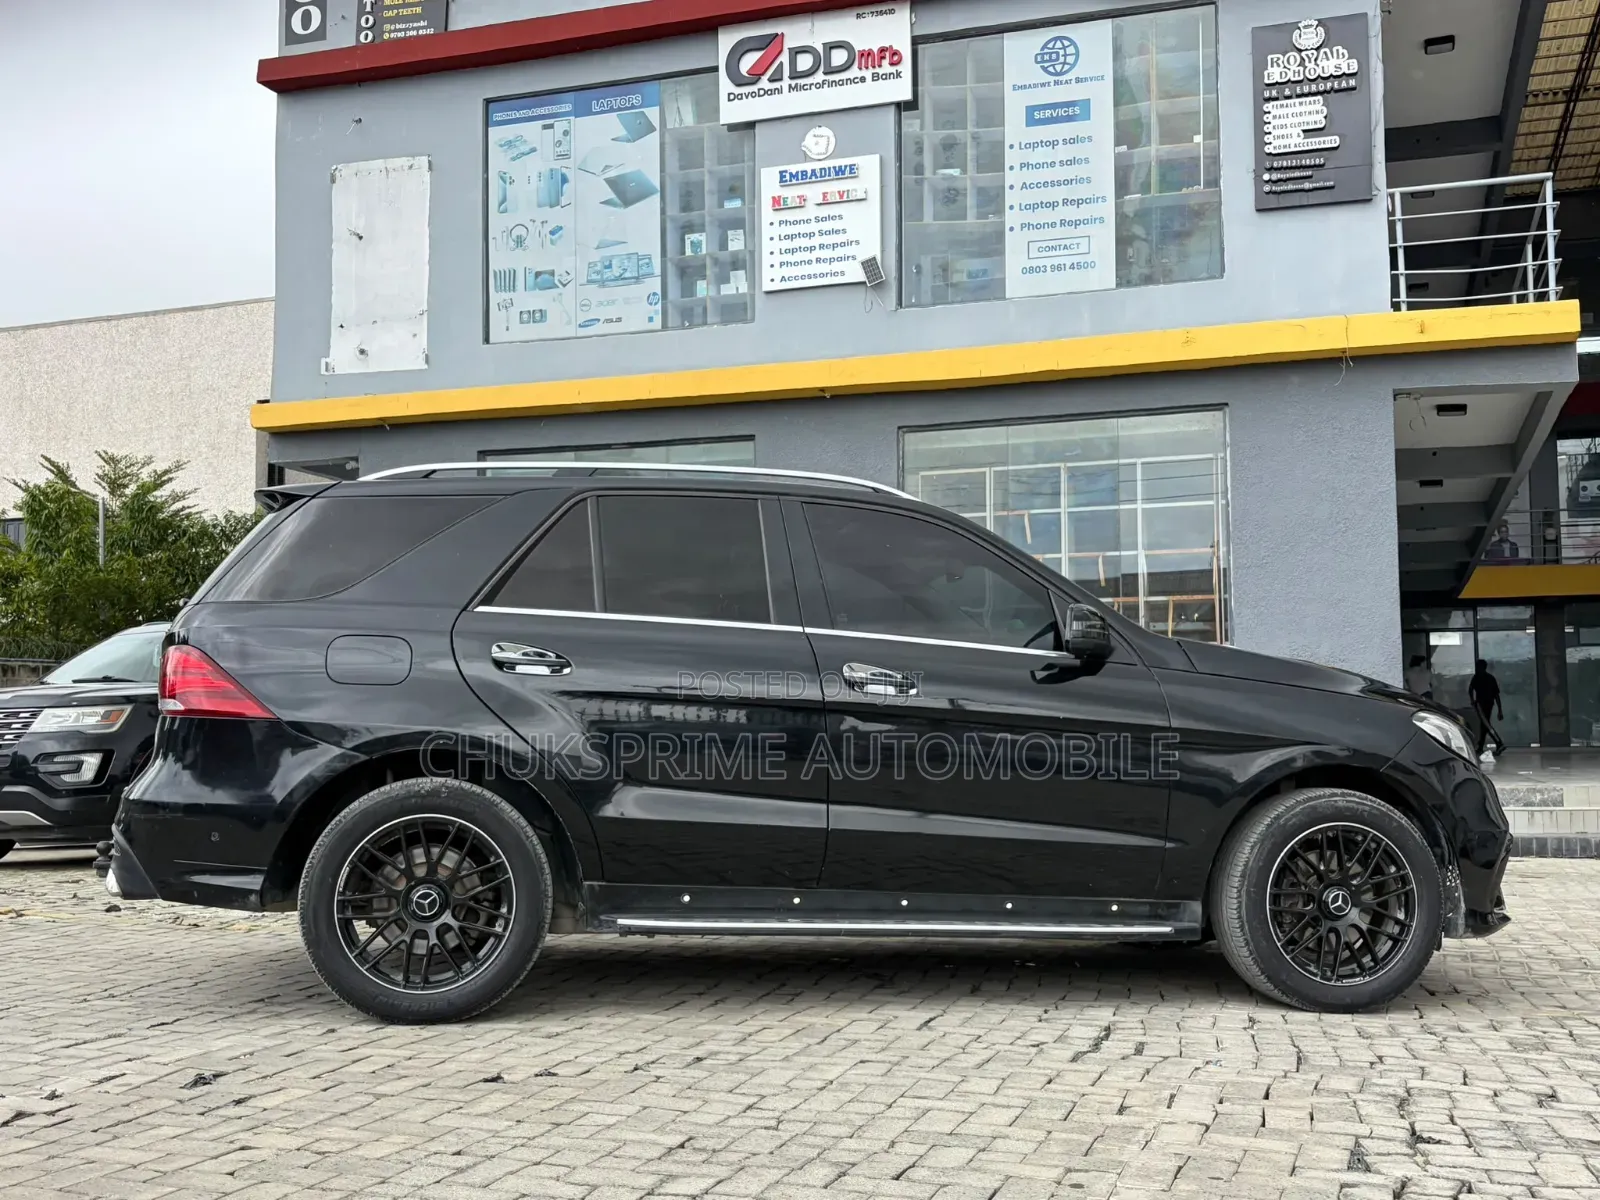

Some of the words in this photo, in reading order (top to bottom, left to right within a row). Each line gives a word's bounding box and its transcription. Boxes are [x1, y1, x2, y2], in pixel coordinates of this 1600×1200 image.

[291, 0, 322, 35] O
[383, 10, 397, 18] GAP
[399, 7, 422, 16] TEETH
[1268, 46, 1347, 69] ROYAL
[1265, 60, 1357, 82] EDHOUSE
[727, 85, 784, 102] DavoDani
[788, 75, 867, 93] Microfinance
[871, 69, 903, 82] Bank
[1263, 89, 1278, 98] UK
[1284, 87, 1291, 95] &
[1296, 79, 1356, 94] EUROPEAN
[592, 94, 642, 112] LAPTOPS
[1271, 101, 1297, 110] FEMALE
[1298, 98, 1321, 107] WEARS
[493, 111, 518, 121] PHONES
[530, 103, 573, 116] ACCESSORIES
[1033, 106, 1080, 119] SERVICES
[1291, 109, 1325, 118] CLOTHING
[1272, 123, 1288, 131] KIDS
[1289, 119, 1324, 128] CLOTHING
[1019, 139, 1060, 152] Laptop
[1062, 134, 1093, 146] sales
[1272, 133, 1293, 141] SHOES
[1273, 143, 1292, 151] HOME
[1293, 138, 1338, 149] ACCESSORIES
[1019, 160, 1056, 171] Phone
[1058, 156, 1090, 167] sales
[1020, 175, 1092, 191] Accessories
[1019, 200, 1060, 213] Laptop
[1062, 194, 1108, 209] Repairs
[778, 216, 812, 227] Phone
[814, 213, 844, 223] Sales
[1020, 220, 1057, 232] Phone
[1059, 215, 1105, 229] Repairs
[778, 231, 816, 242] Laptop
[818, 227, 847, 236] Sales
[779, 245, 817, 256] Laptop
[818, 239, 860, 251] Repairs
[1037, 242, 1081, 253] CONTACT
[779, 258, 813, 268] Phone
[815, 254, 857, 266] Repairs
[1021, 265, 1047, 275] 0803
[1050, 263, 1067, 272] 961
[1068, 261, 1096, 271] 4500
[779, 270, 846, 283] Accessories
